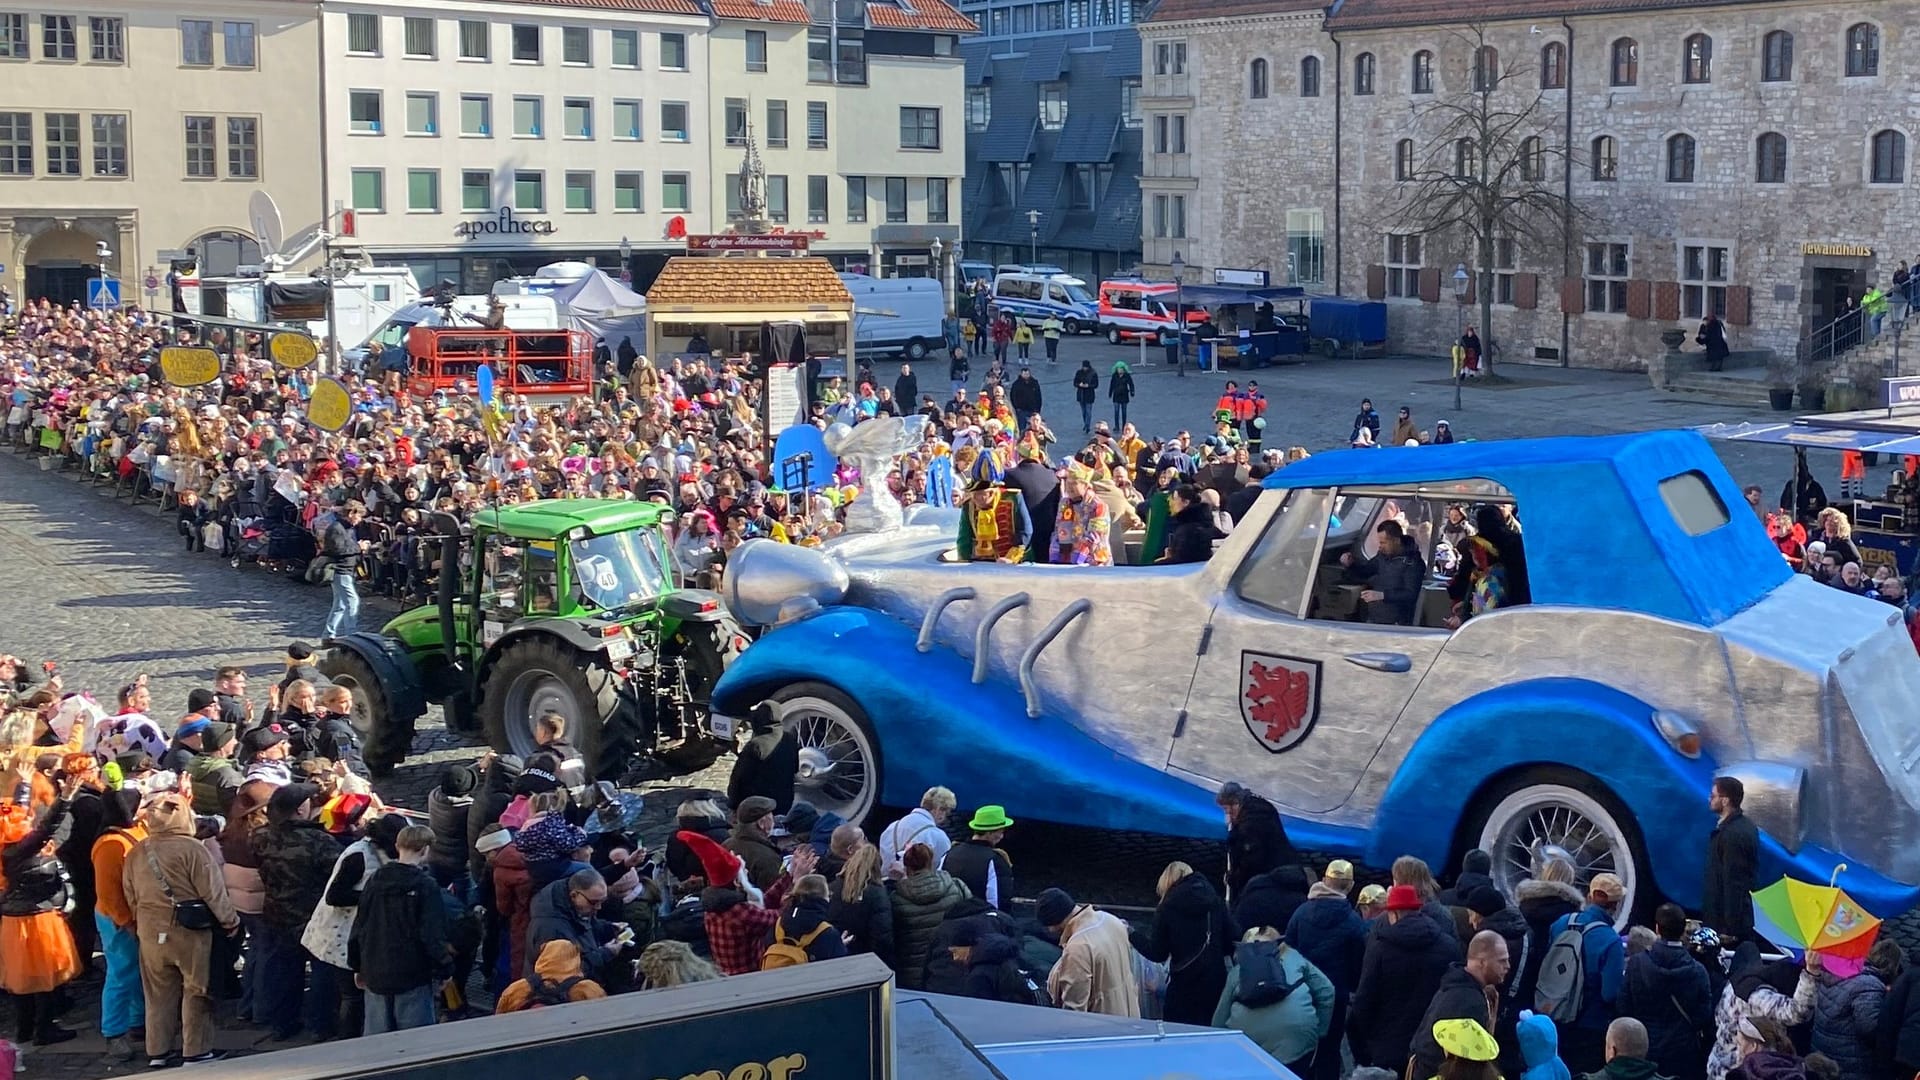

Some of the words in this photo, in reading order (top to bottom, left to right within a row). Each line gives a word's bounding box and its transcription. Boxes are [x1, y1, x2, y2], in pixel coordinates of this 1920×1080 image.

[459, 206, 558, 240] apotheca
[601, 574, 615, 588] 40
[528, 768, 556, 782] SQUAD
